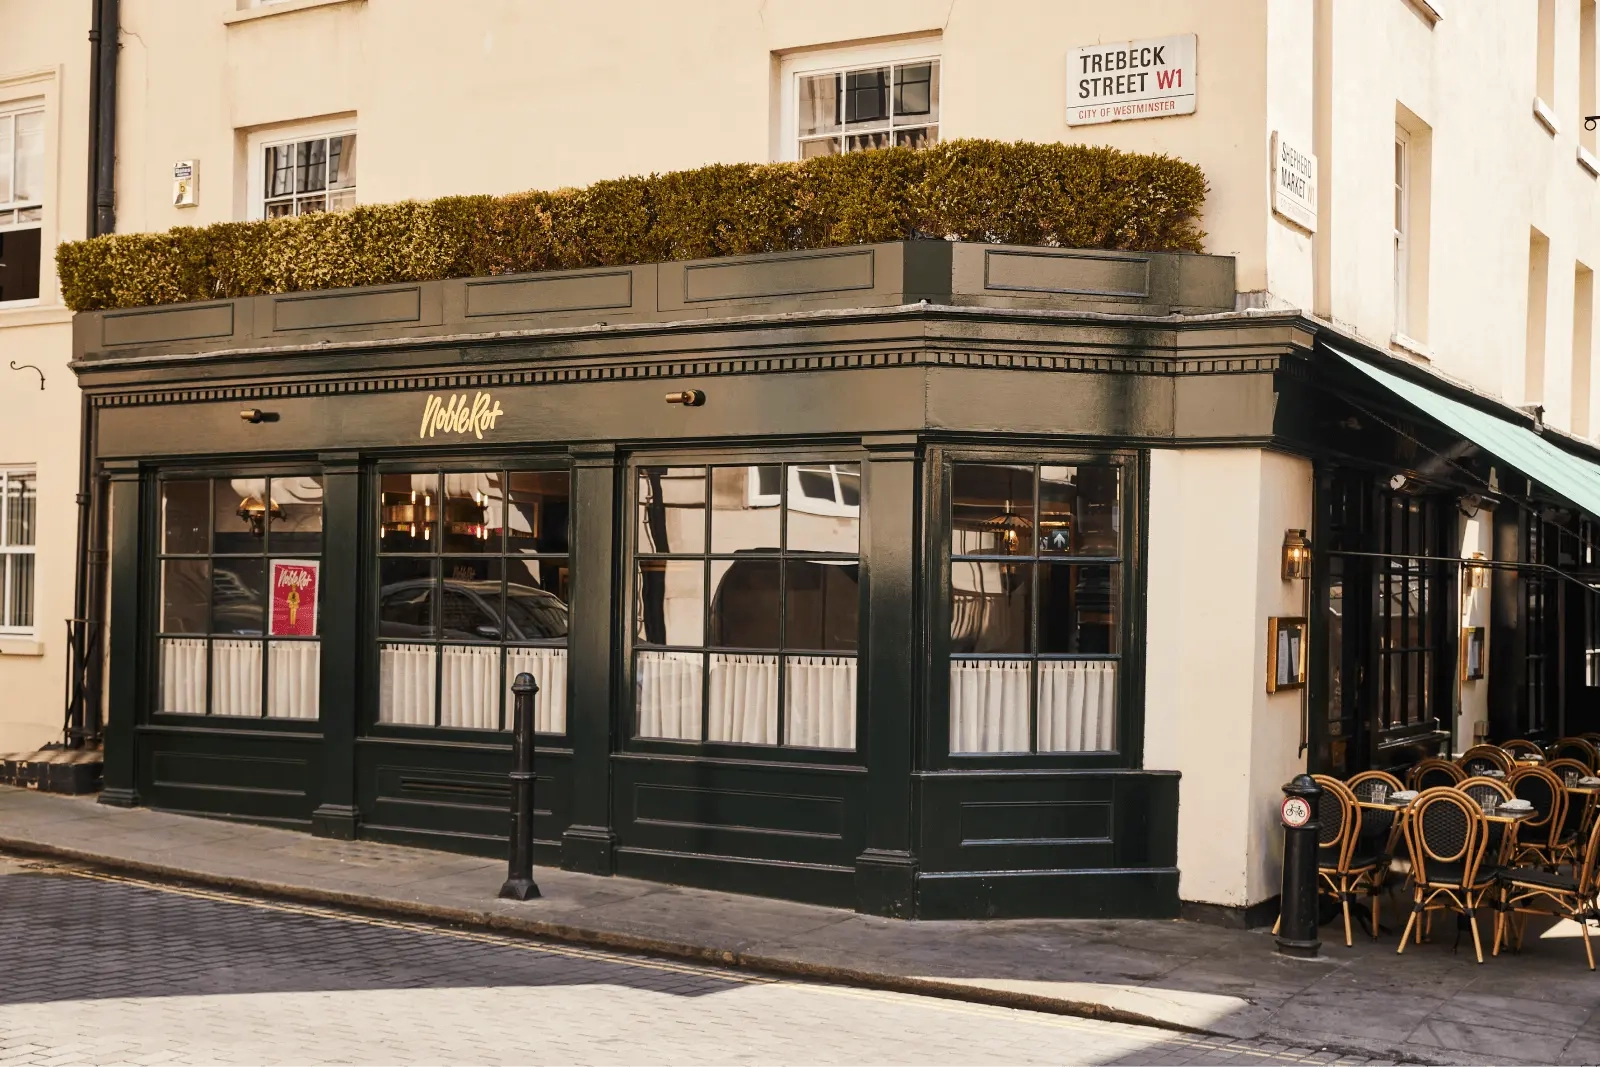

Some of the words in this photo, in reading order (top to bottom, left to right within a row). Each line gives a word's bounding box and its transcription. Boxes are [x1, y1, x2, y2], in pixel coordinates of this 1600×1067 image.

[1080, 45, 1165, 74] TREBECK
[1079, 72, 1149, 99] STREET
[1156, 68, 1182, 90] W1
[1078, 109, 1097, 120] CITY
[1100, 107, 1111, 117] OF
[1113, 100, 1175, 116] WESTMINSTER
[1281, 141, 1312, 179] SHEPHERD
[1281, 166, 1306, 199] MARKET
